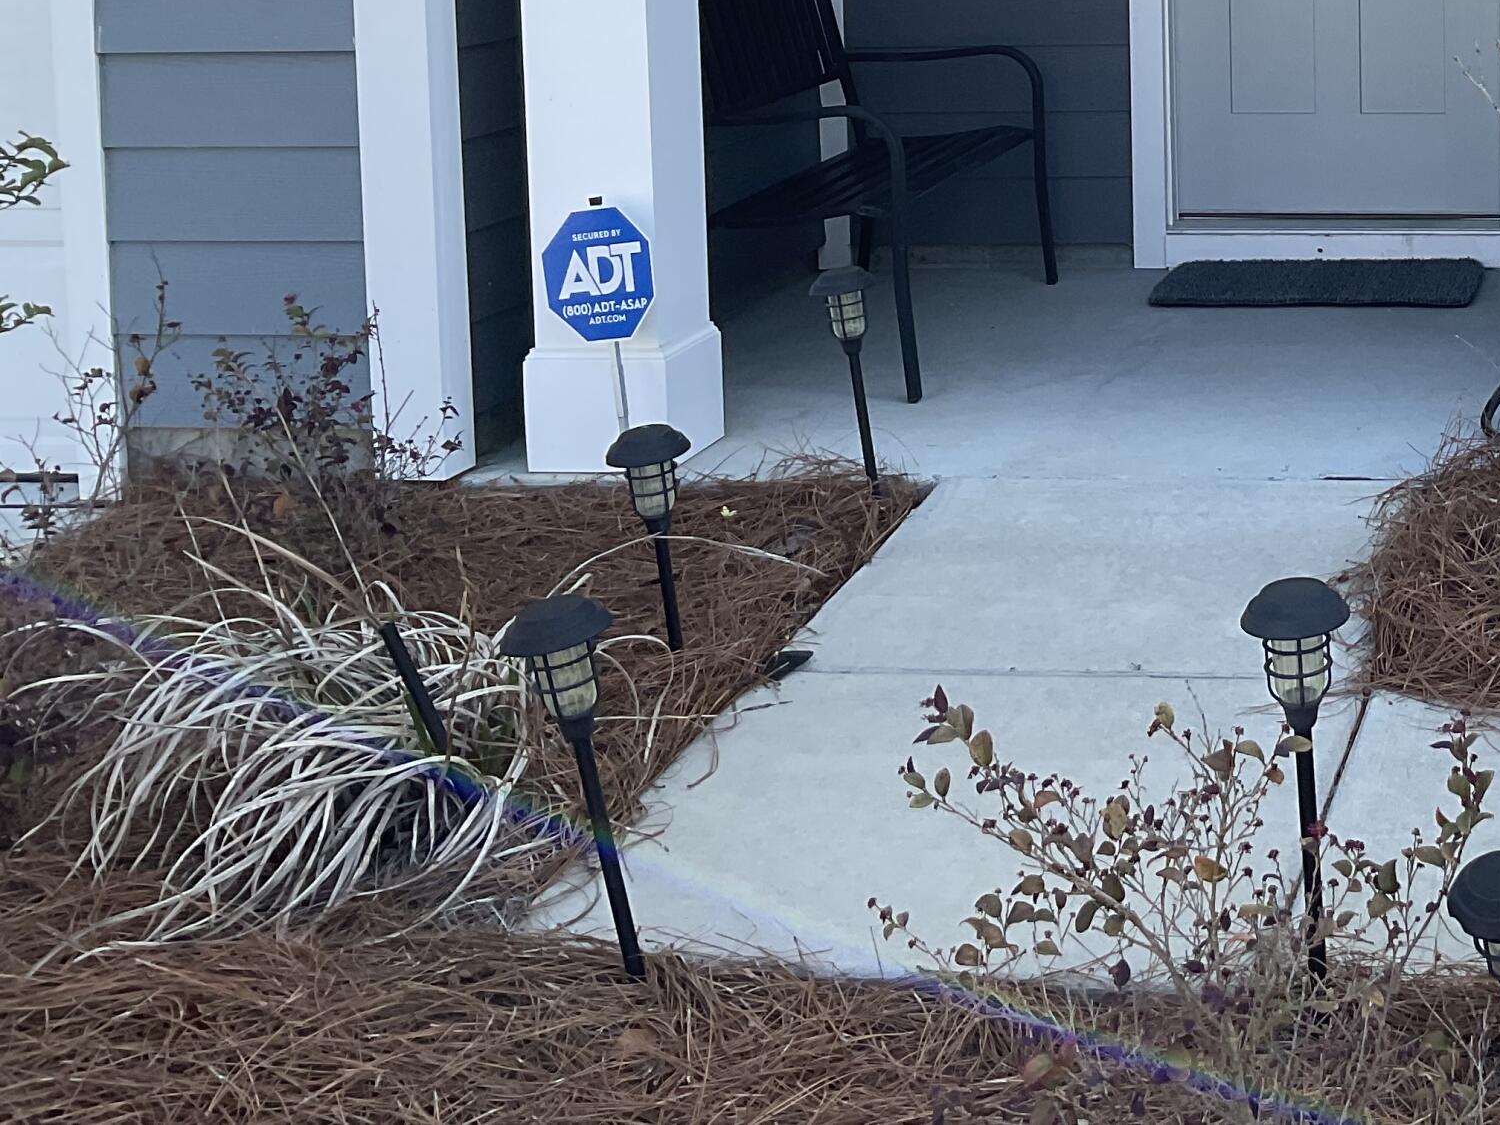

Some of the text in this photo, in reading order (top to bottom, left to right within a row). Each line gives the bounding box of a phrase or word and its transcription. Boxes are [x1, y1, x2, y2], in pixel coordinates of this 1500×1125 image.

[572, 229, 621, 241] SECURED BY
[558, 241, 642, 300] ADT
[562, 297, 648, 319] (800) ADT-ASAP
[589, 314, 627, 325] ADT.COM
